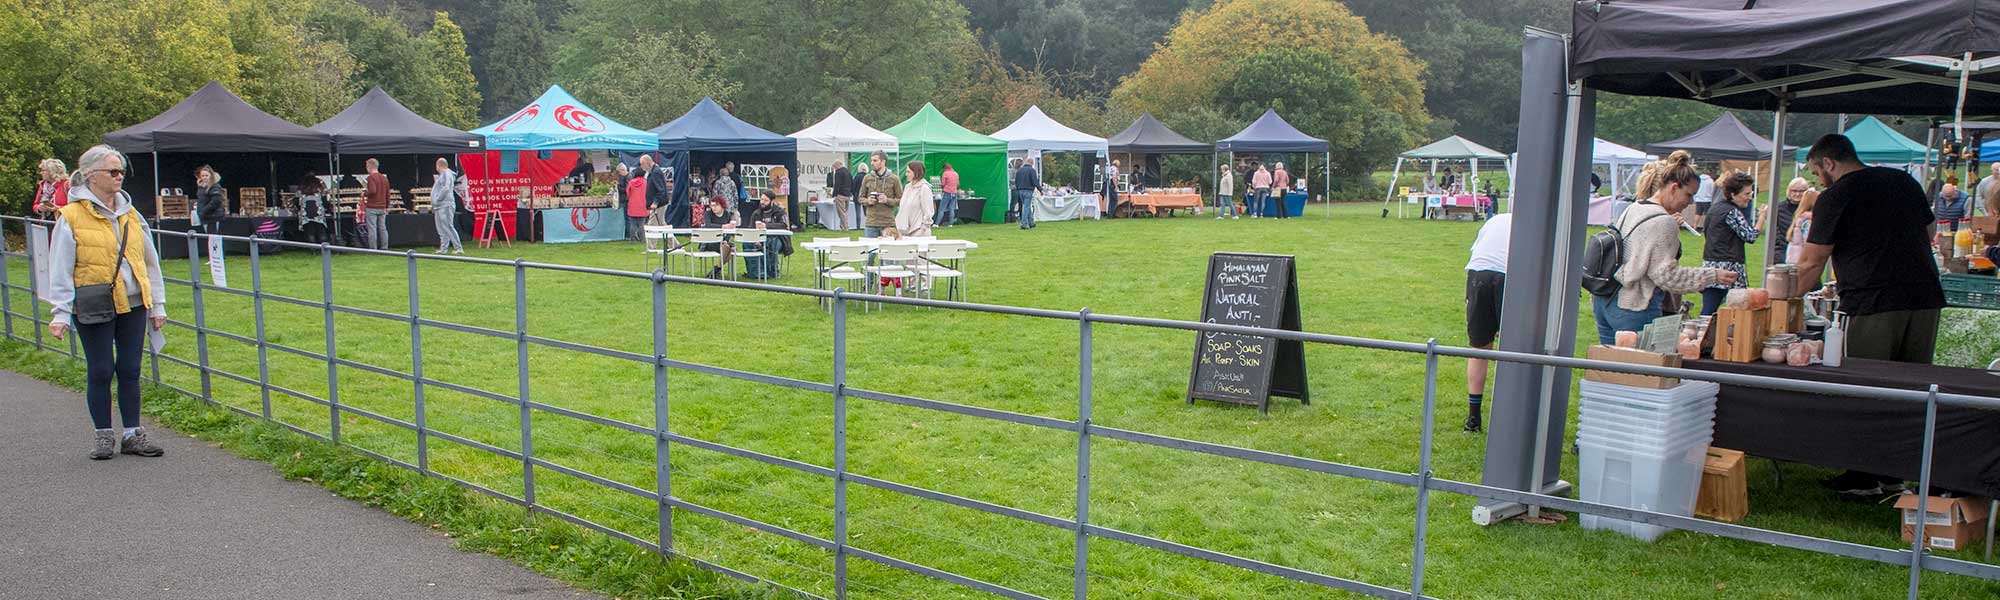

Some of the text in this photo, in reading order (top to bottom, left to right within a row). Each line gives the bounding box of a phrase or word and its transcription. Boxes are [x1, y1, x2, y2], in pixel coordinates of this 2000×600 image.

[1223, 261, 1269, 273] HIMALAYAN
[1217, 272, 1266, 285] PINK SALT
[1215, 288, 1259, 305] NATURAL
[1207, 339, 1231, 352] SOAP
[1239, 354, 1260, 367] SKIN
